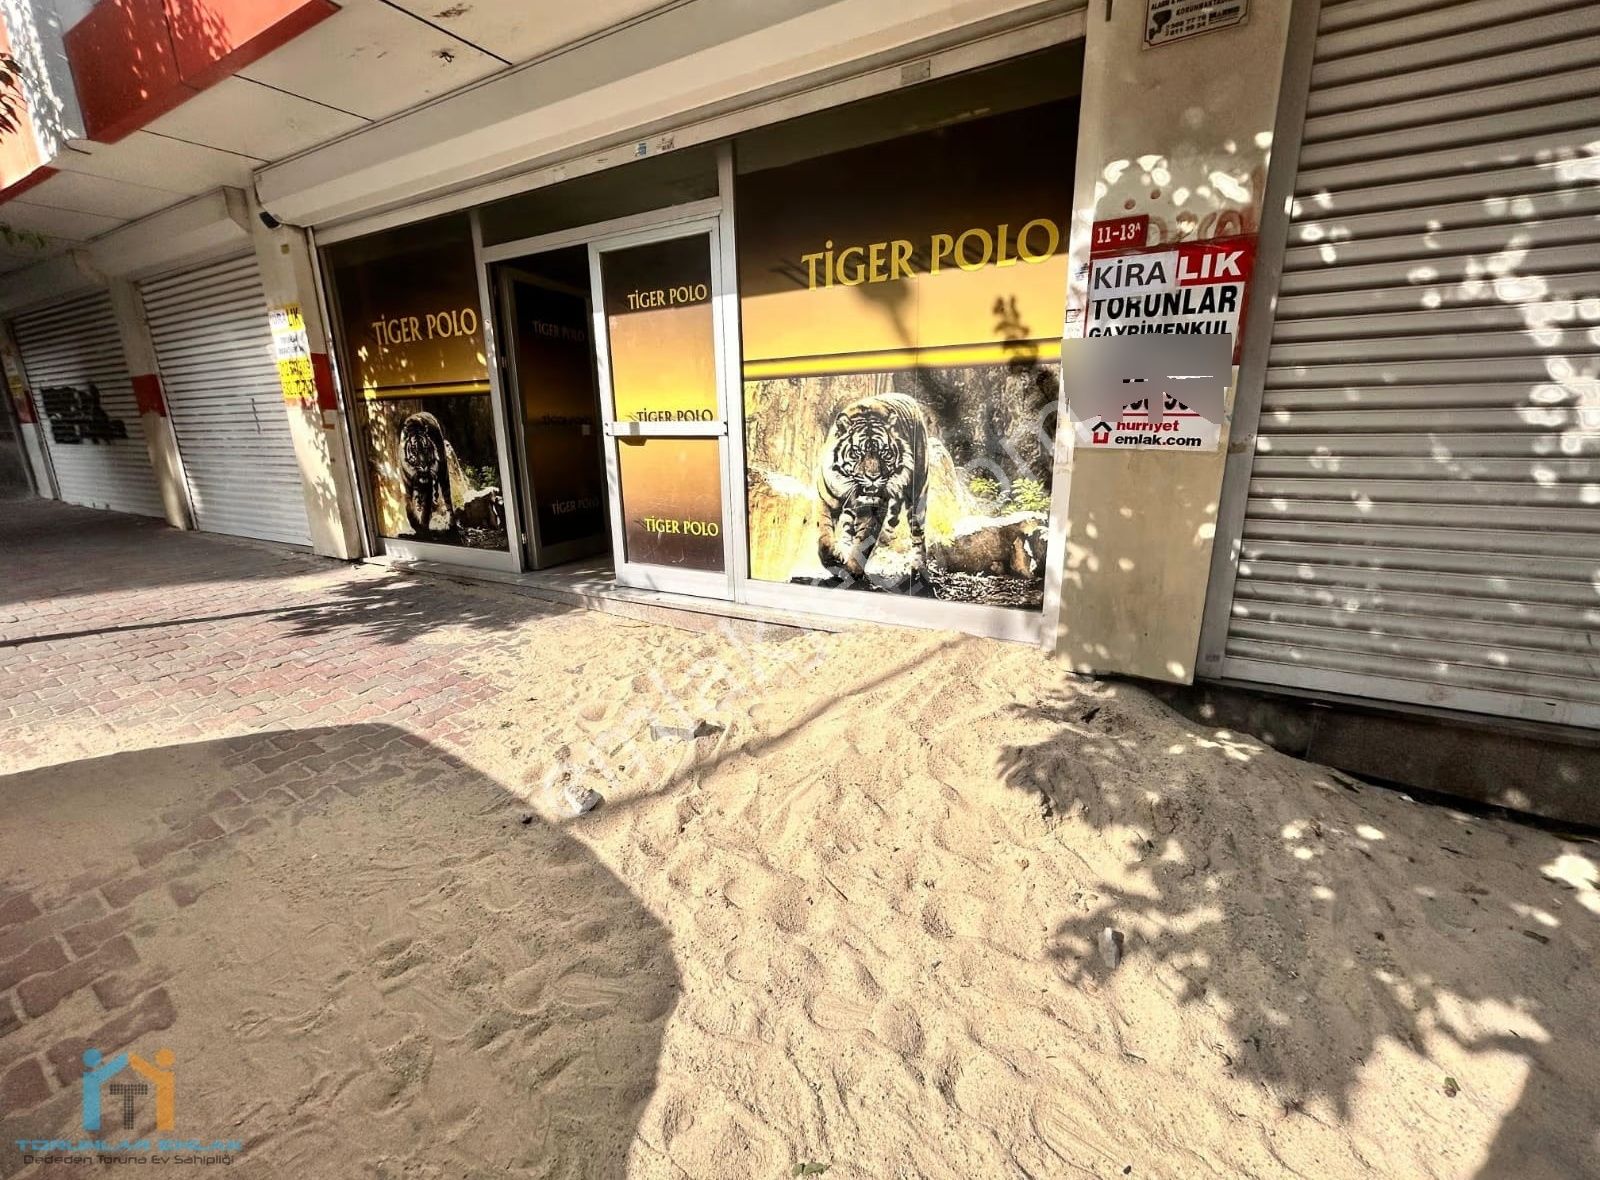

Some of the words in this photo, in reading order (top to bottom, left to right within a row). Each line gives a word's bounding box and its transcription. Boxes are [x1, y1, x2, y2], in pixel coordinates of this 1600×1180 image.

[801, 239, 917, 291] TİGER
[930, 218, 1060, 276] POLO
[627, 290, 667, 311] TİGER
[669, 283, 708, 304] POLO
[1092, 285, 1238, 320] TORUNLAR
[372, 313, 424, 346] TİGER
[427, 307, 478, 340] POLO
[676, 409, 714, 422] POLO
[1115, 434, 1202, 447] emlak.com
[644, 514, 681, 534] TİGER
[683, 520, 719, 537] POLO
